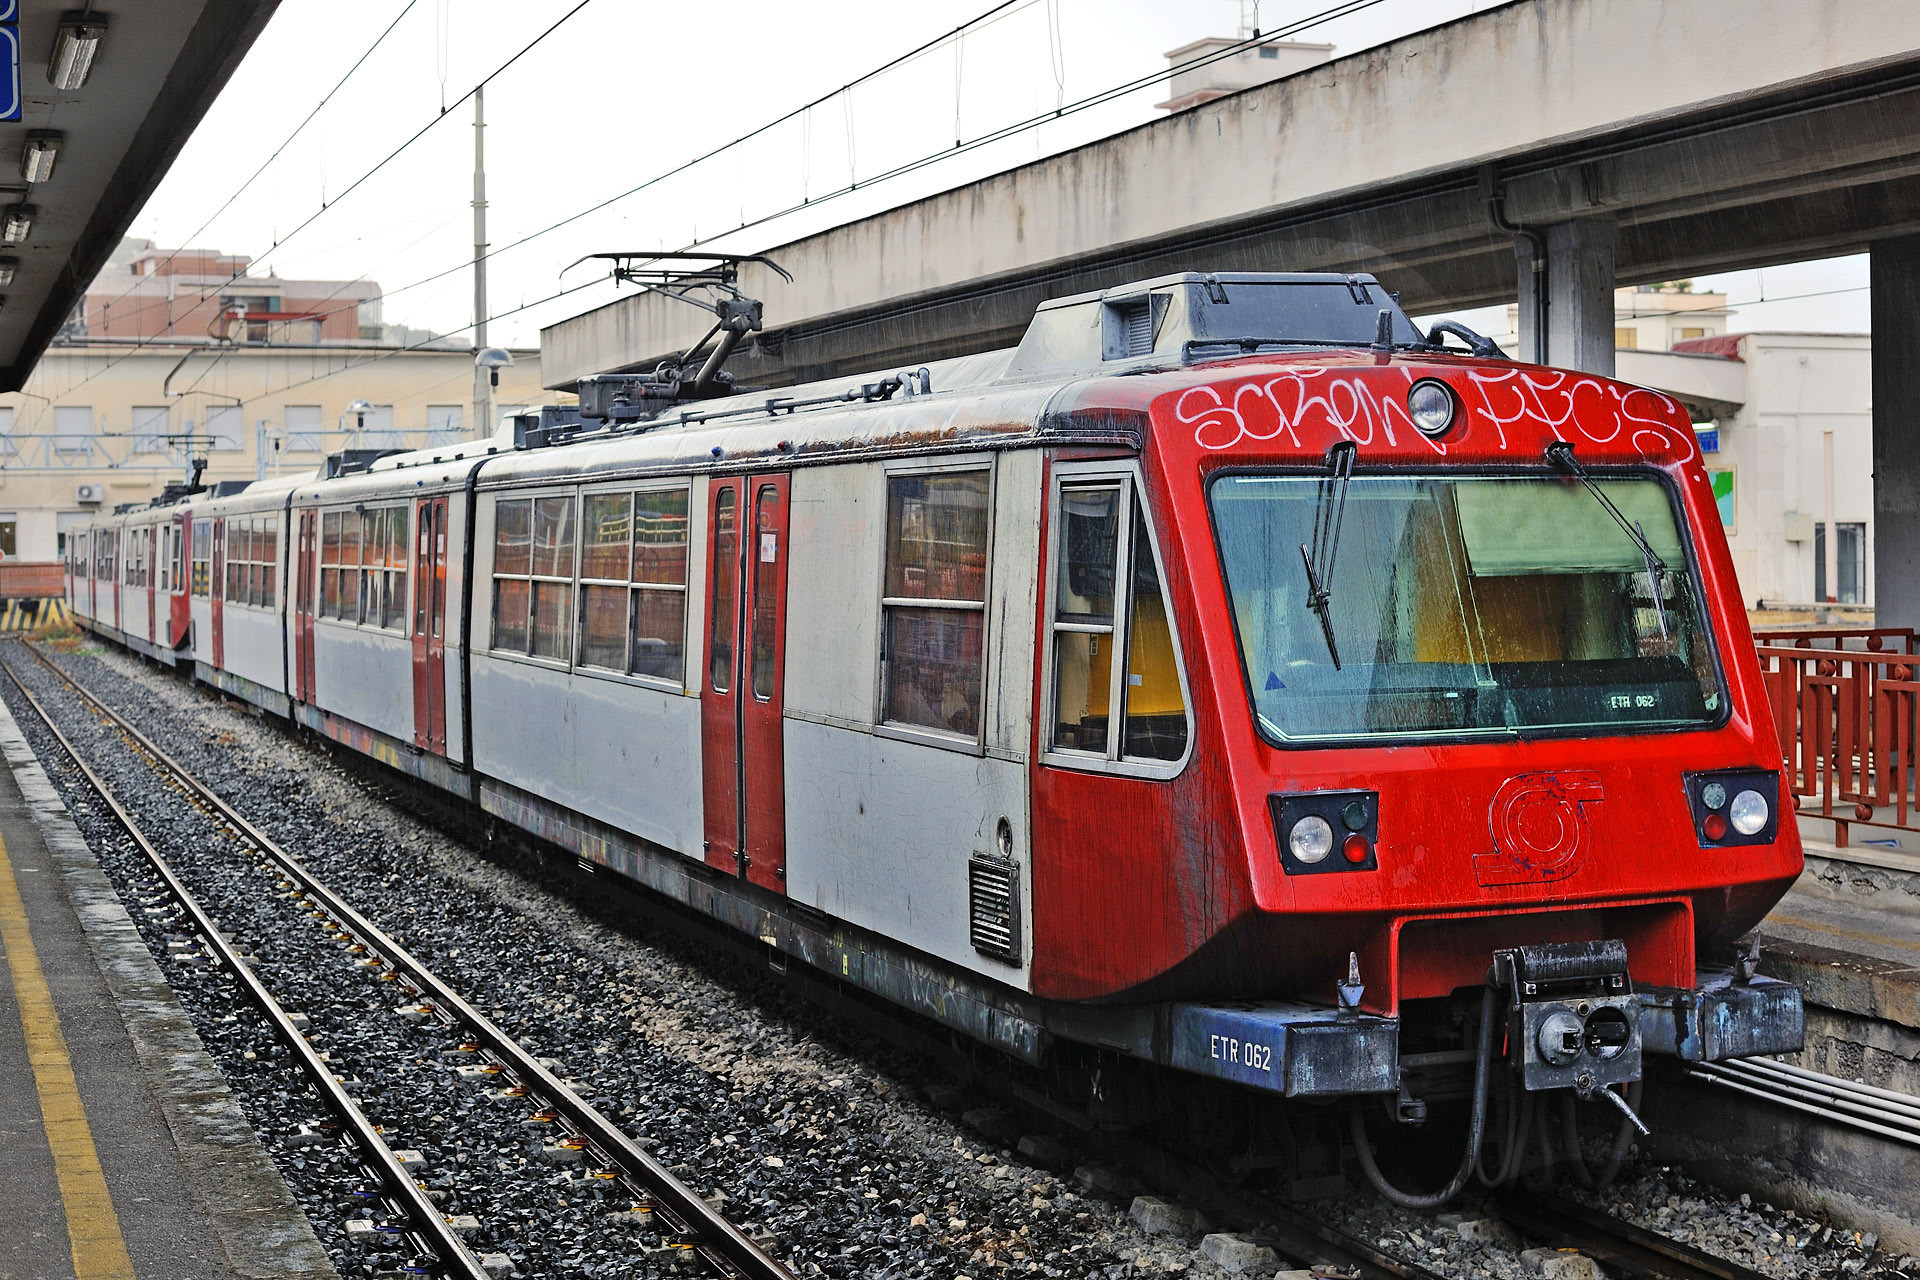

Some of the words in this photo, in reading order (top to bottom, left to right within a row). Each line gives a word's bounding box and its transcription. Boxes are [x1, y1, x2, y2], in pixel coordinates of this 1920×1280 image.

[1611, 695, 1631, 709] ETR
[1635, 695, 1655, 707] 062
[1211, 1034, 1239, 1064] ETR
[1244, 1042, 1271, 1071] 062
